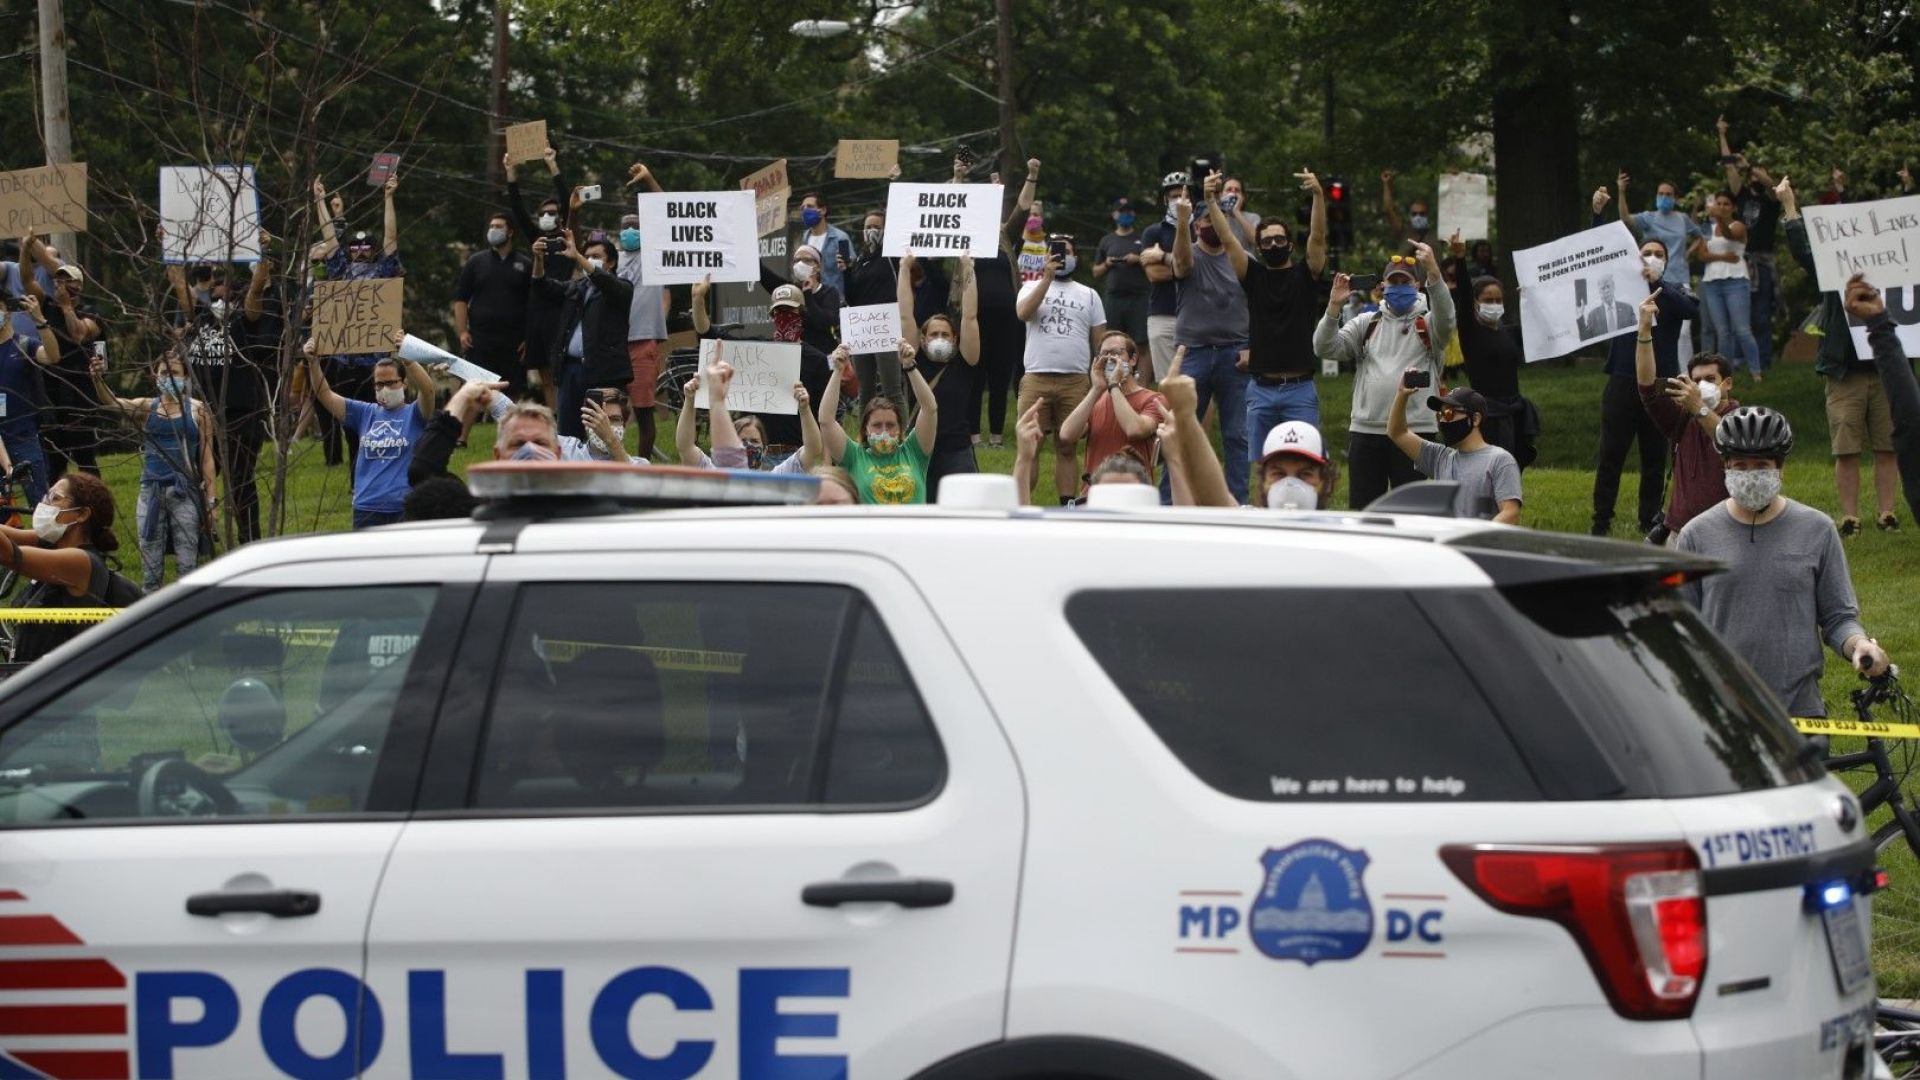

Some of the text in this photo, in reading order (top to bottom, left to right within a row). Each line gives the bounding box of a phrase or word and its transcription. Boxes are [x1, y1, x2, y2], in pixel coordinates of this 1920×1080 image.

[852, 143, 881, 153] BLACK
[666, 202, 718, 218] BLACK
[918, 193, 968, 208] BLACK
[8, 203, 73, 233] POLICE
[919, 214, 961, 229] LIVES
[1812, 207, 1918, 244] BLACK LIVES
[671, 225, 713, 242] LIVES
[910, 232, 971, 249] MATTER
[662, 250, 723, 268] MATTER
[1537, 246, 1604, 272] THE BIBLE IS NO PROP
[1538, 273, 1551, 282] FOR
[1570, 261, 1586, 272] STAR
[1587, 249, 1628, 266] PRESIDENTS
[1836, 237, 1908, 277] MATTER!
[318, 283, 385, 304] BLACK
[319, 303, 379, 324] LIVES
[849, 312, 890, 325] BLACK
[314, 323, 395, 354] MATTER
[851, 325, 889, 337] LIVES
[1270, 775, 1466, 797] We are here to help
[1702, 823, 1816, 868] 1ST DISTRICT
[1178, 906, 1241, 939] MP
[1386, 909, 1443, 943] DC
[135, 965, 850, 1080] POLICE
